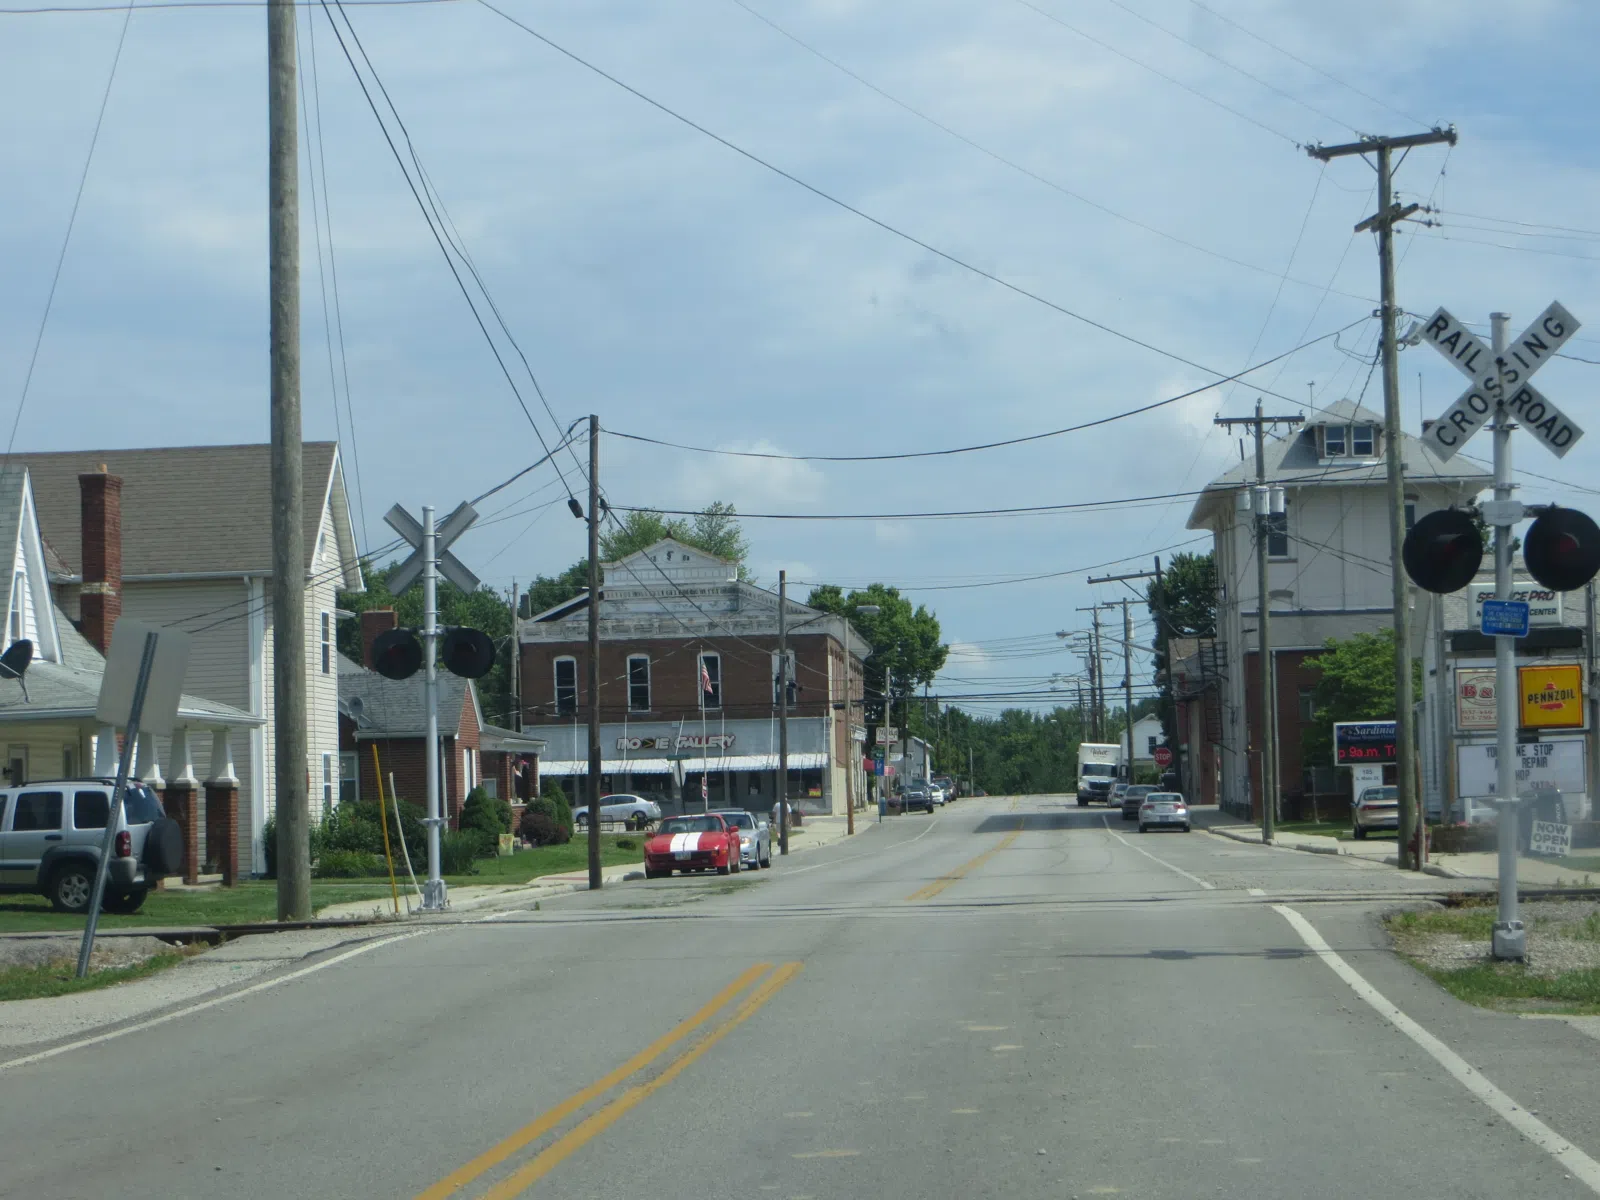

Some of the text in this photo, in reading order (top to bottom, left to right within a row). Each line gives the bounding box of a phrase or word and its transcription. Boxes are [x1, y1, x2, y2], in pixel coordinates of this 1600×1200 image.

[1426, 314, 1573, 448] RAIL ROAD
[1435, 316, 1565, 447] CROSSING
[1529, 590, 1555, 601] PRO
[1529, 607, 1557, 616] CENTER
[1527, 688, 1576, 704] PENNZOIL
[1354, 725, 1395, 735] Sardinia
[674, 735, 736, 750] GALLERY
[1155, 752, 1171, 760] STOP
[1516, 745, 1526, 757] NE
[1533, 744, 1554, 756] STOP
[1521, 756, 1548, 768] REPAIR
[1515, 769, 1530, 781] HOP
[1536, 822, 1568, 835] NOW
[1533, 833, 1569, 847] OPEN
